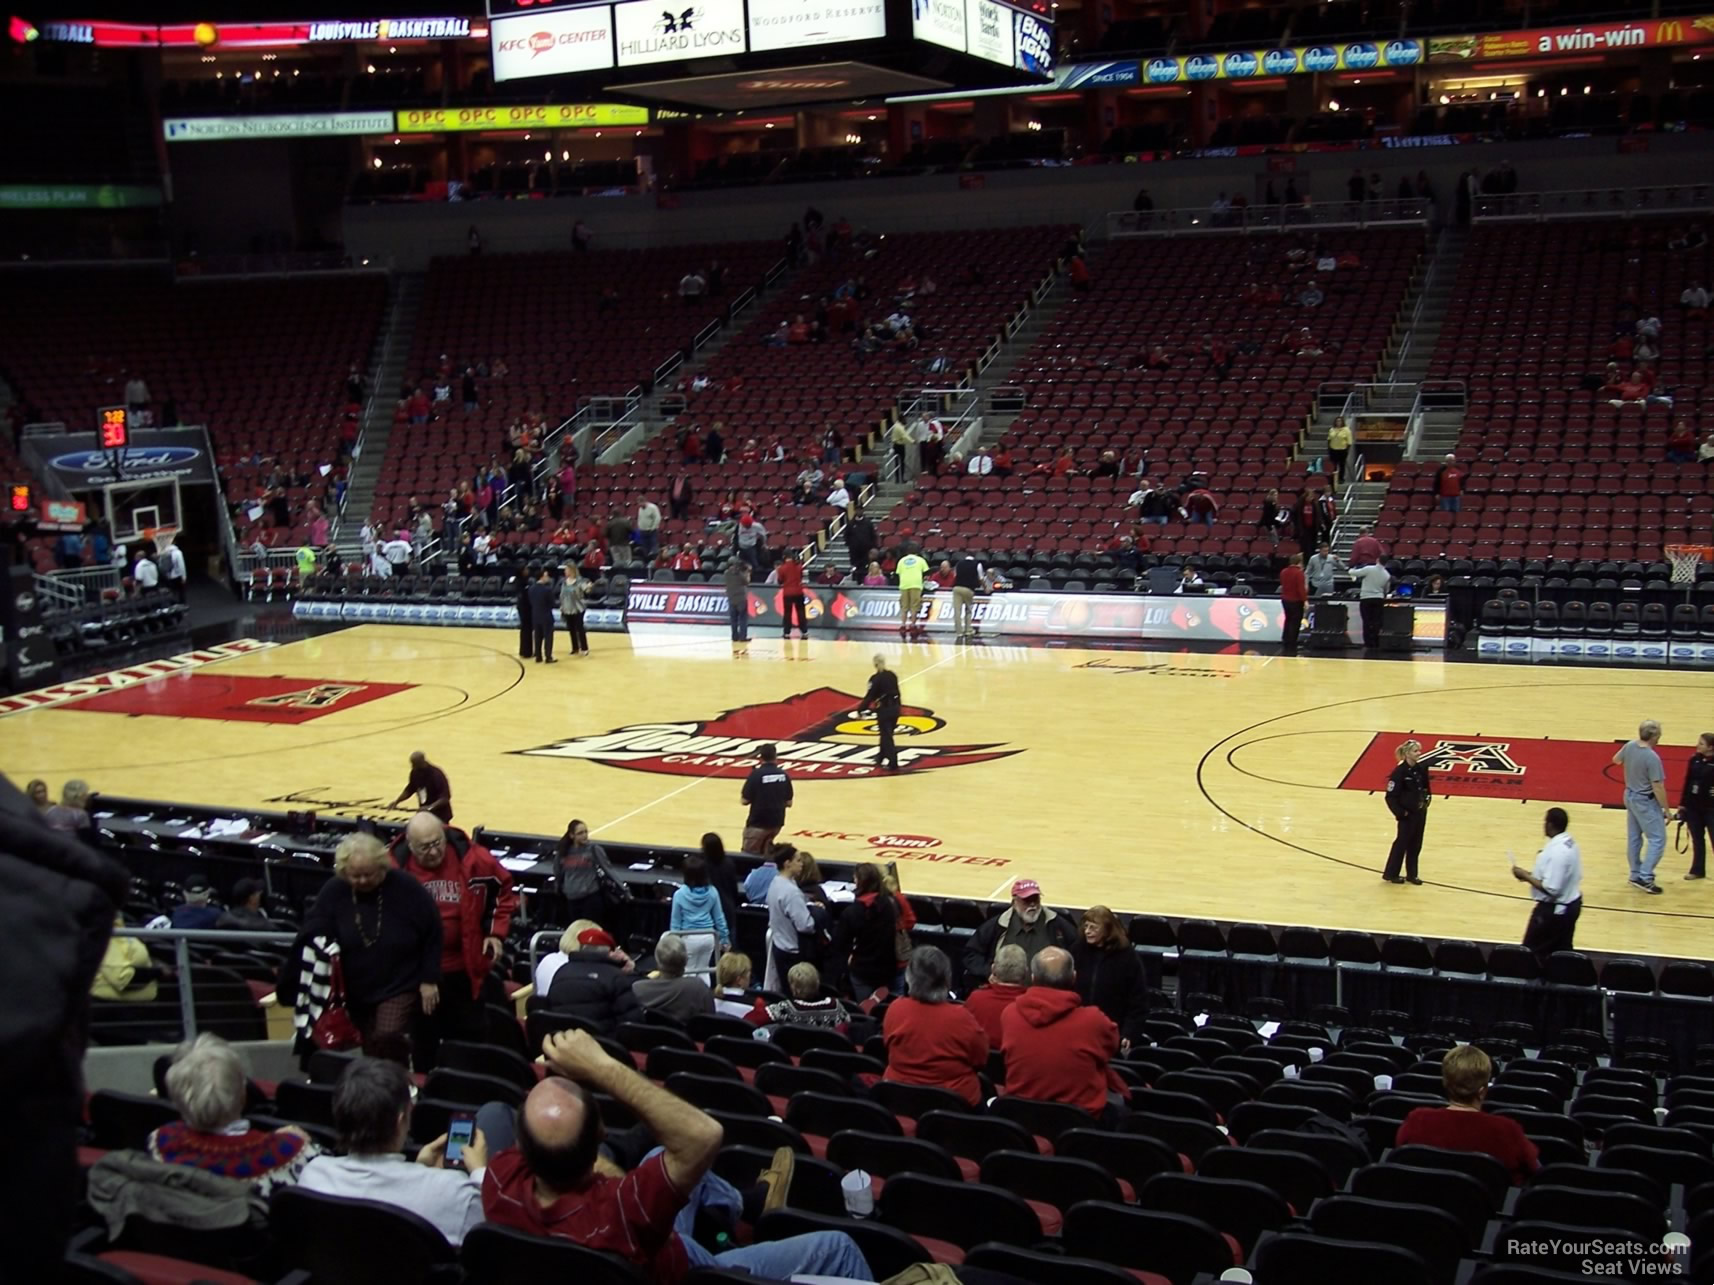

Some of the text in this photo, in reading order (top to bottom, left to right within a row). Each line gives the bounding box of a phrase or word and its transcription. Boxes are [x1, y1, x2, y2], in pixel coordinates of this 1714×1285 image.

[752, 4, 882, 27] WOODFORD RESERVE
[309, 19, 470, 41] LOUISVILLE BASKETBALL
[1022, 15, 1051, 50] BUD
[1538, 36, 1552, 52] a
[1556, 25, 1645, 51] win-win
[498, 39, 526, 52] KFC
[559, 29, 606, 45] CENTER
[621, 28, 741, 55] HILLIARD LYONS
[1091, 74, 1114, 84] SINCE
[408, 111, 446, 123] OPC
[459, 109, 496, 122] OPC
[509, 106, 546, 120] OPC
[560, 105, 597, 118] OPC
[331, 116, 390, 131] INSTITUTE
[83, 450, 173, 470] Frd
[791, 829, 941, 849] KFC Yum!
[875, 850, 1012, 867] CENTER
